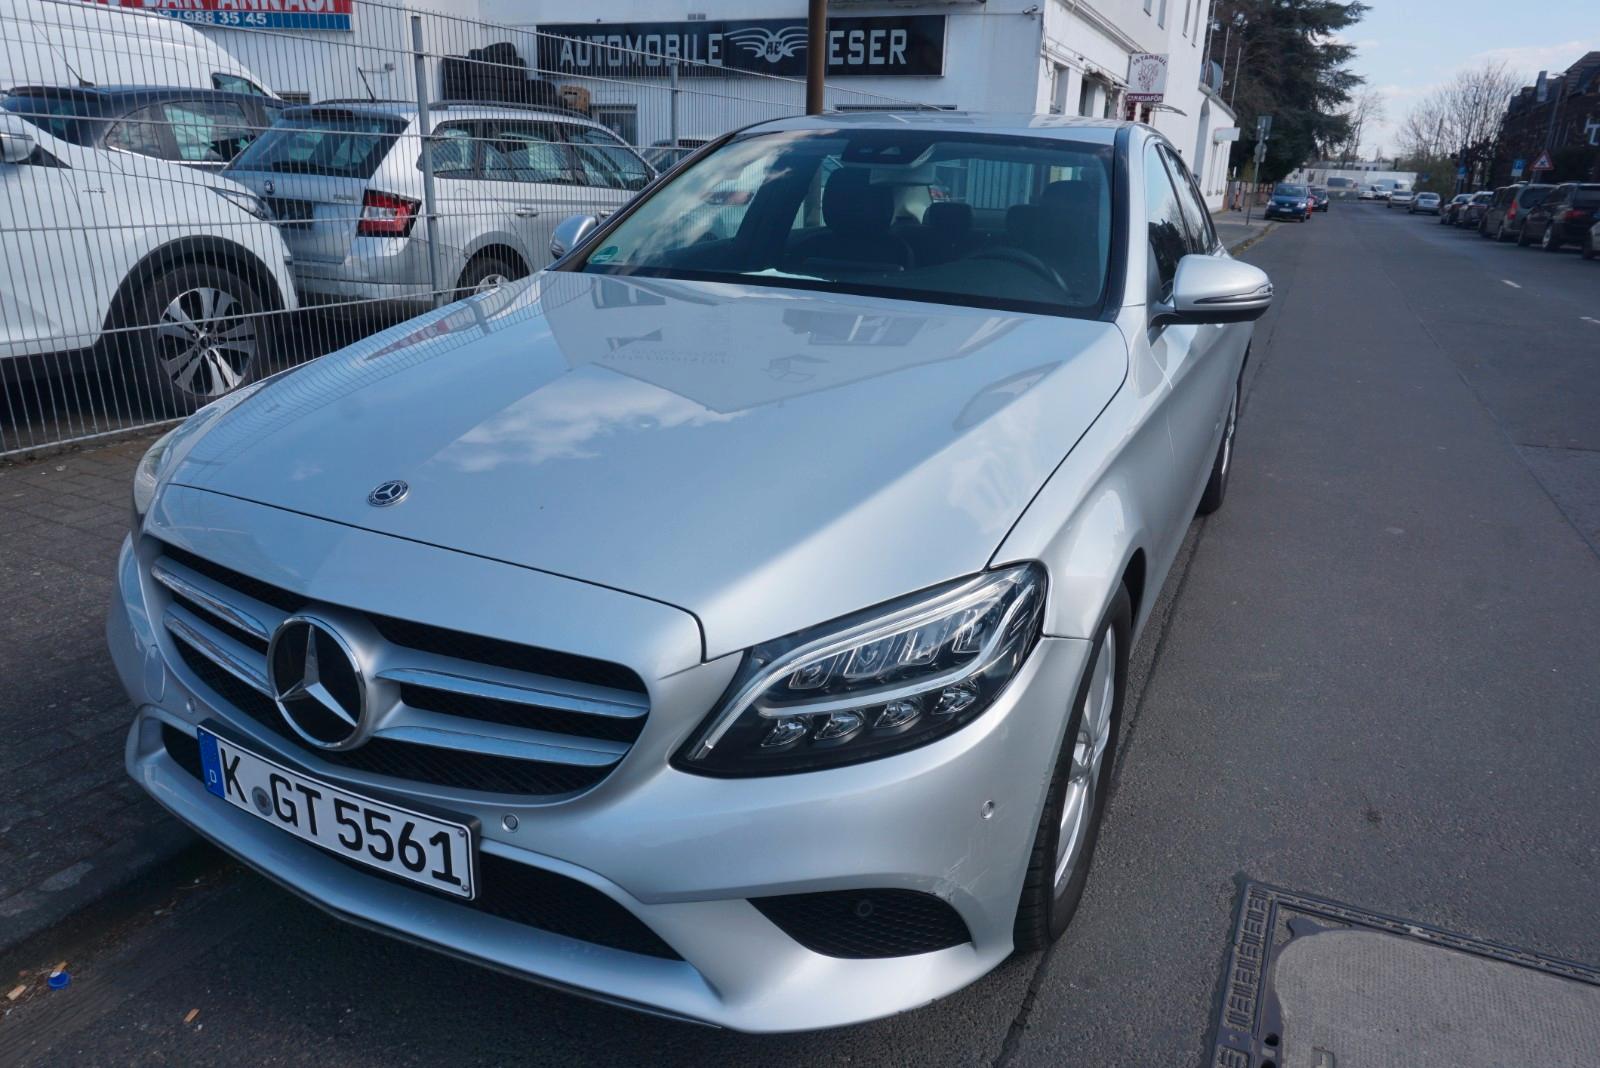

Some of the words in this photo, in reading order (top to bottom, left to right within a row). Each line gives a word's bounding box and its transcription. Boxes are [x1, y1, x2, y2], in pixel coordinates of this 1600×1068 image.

[219, 12, 240, 25] 35
[246, 13, 267, 25] 45
[560, 33, 723, 67] AUTOMOBILE
[829, 29, 907, 65] ESER
[209, 769, 217, 784] D
[220, 747, 248, 804] K
[269, 772, 322, 837] GT
[333, 797, 462, 886] 5561
